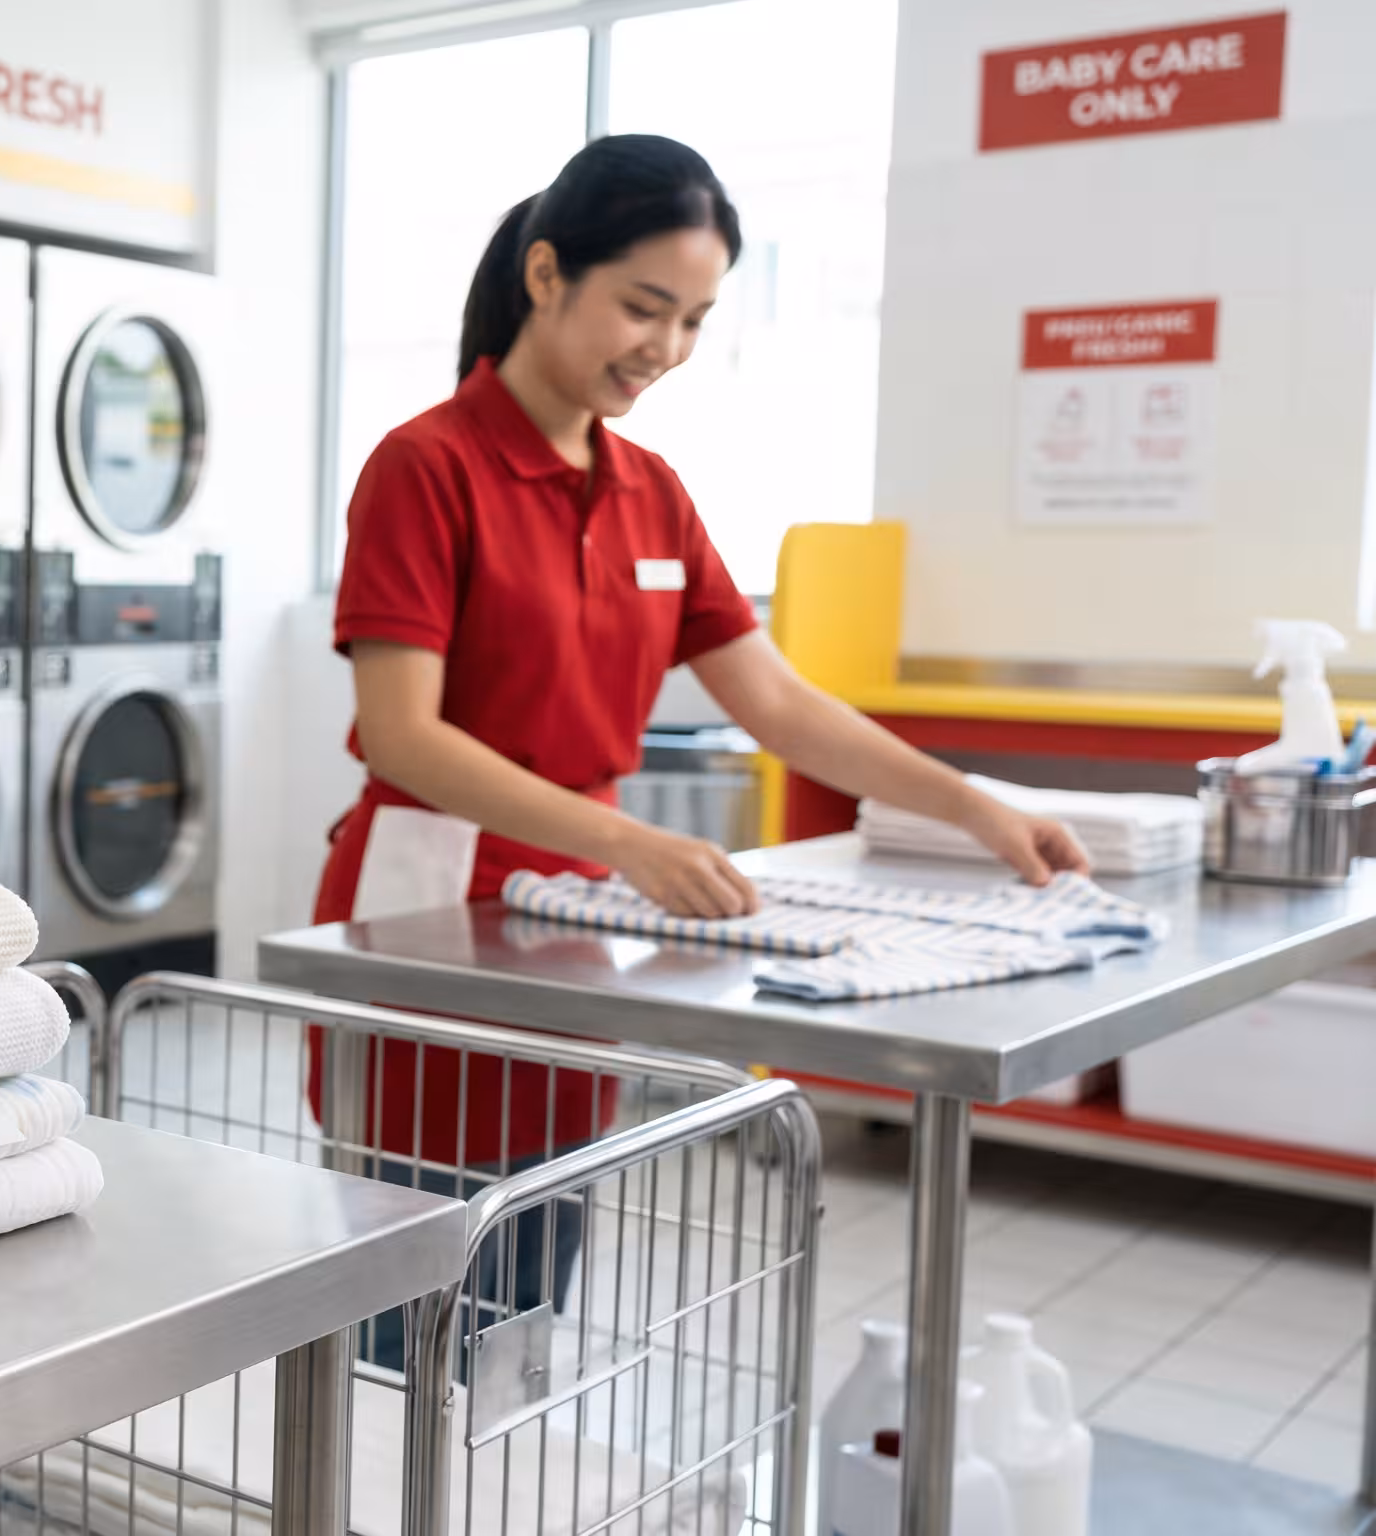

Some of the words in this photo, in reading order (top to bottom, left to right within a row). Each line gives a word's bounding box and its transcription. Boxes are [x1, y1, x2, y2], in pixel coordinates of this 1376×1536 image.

[1014, 50, 1124, 95] BABY
[1129, 32, 1245, 80] CARE
[1070, 80, 1180, 127] ONLY
